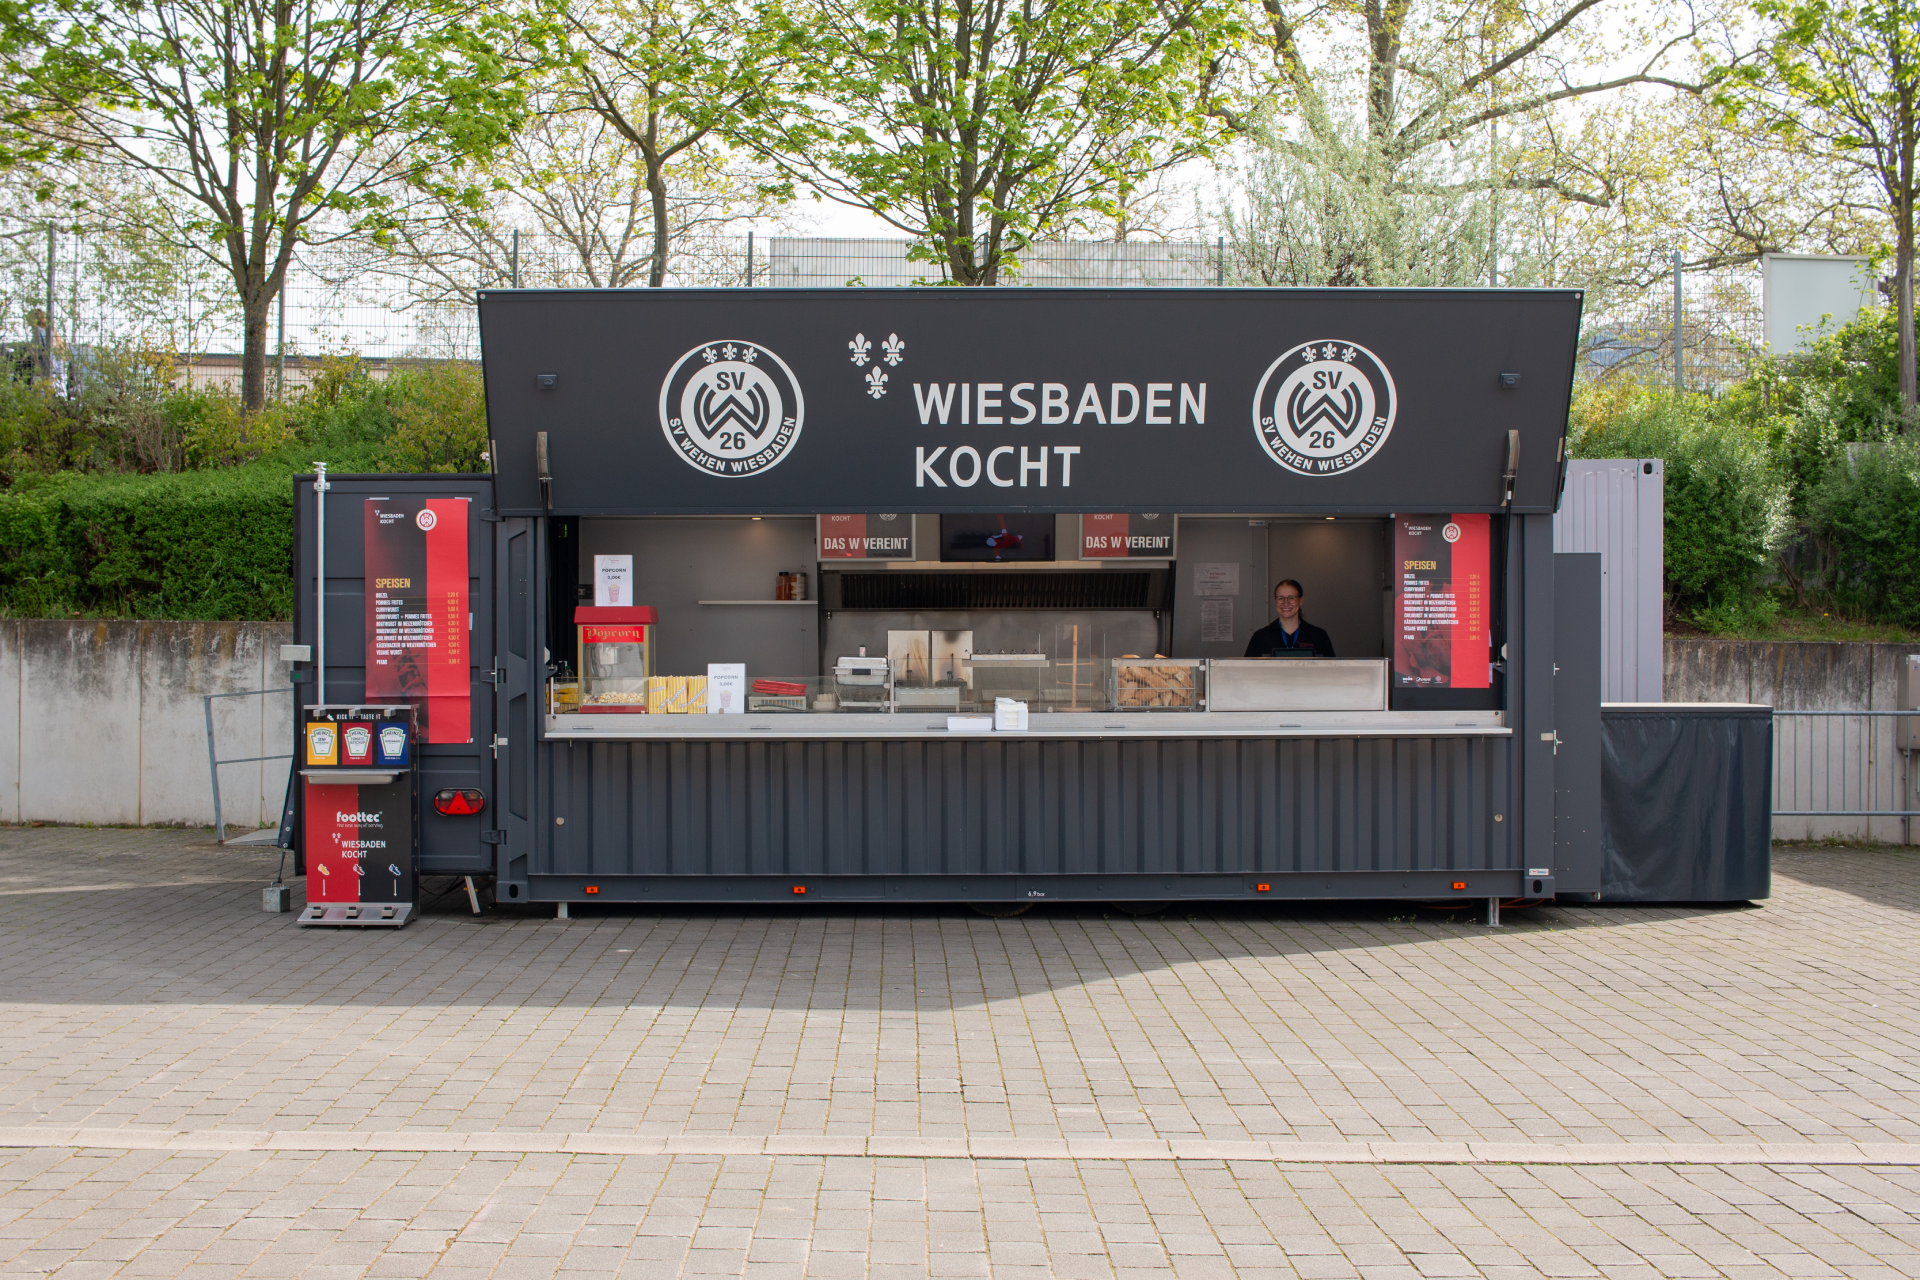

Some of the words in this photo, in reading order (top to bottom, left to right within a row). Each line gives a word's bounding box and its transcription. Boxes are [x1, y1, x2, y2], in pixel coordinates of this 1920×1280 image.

[717, 372, 745, 390] SV
[1313, 371, 1342, 389] SV
[913, 382, 1206, 424] WIESBADEN
[670, 418, 685, 435] SV
[680, 438, 725, 472] WEHEN
[731, 417, 795, 472] WIESBADEN
[720, 432, 746, 450] 26
[1262, 417, 1276, 433] SV
[1270, 436, 1313, 470] WEHEN
[1318, 416, 1386, 470] WIESBADEN
[1309, 431, 1335, 448] 26
[916, 446, 1080, 488] KOCHT
[824, 538, 845, 549] DAS
[849, 538, 859, 549] W
[863, 538, 908, 549] VEREINT
[1086, 537, 1107, 548] DAS
[1111, 537, 1121, 548] W
[1125, 537, 1170, 548] VEREINT
[1404, 561, 1436, 570] SPEISEN
[376, 578, 410, 588] SPEISEN
[585, 628, 640, 640] Popcorn
